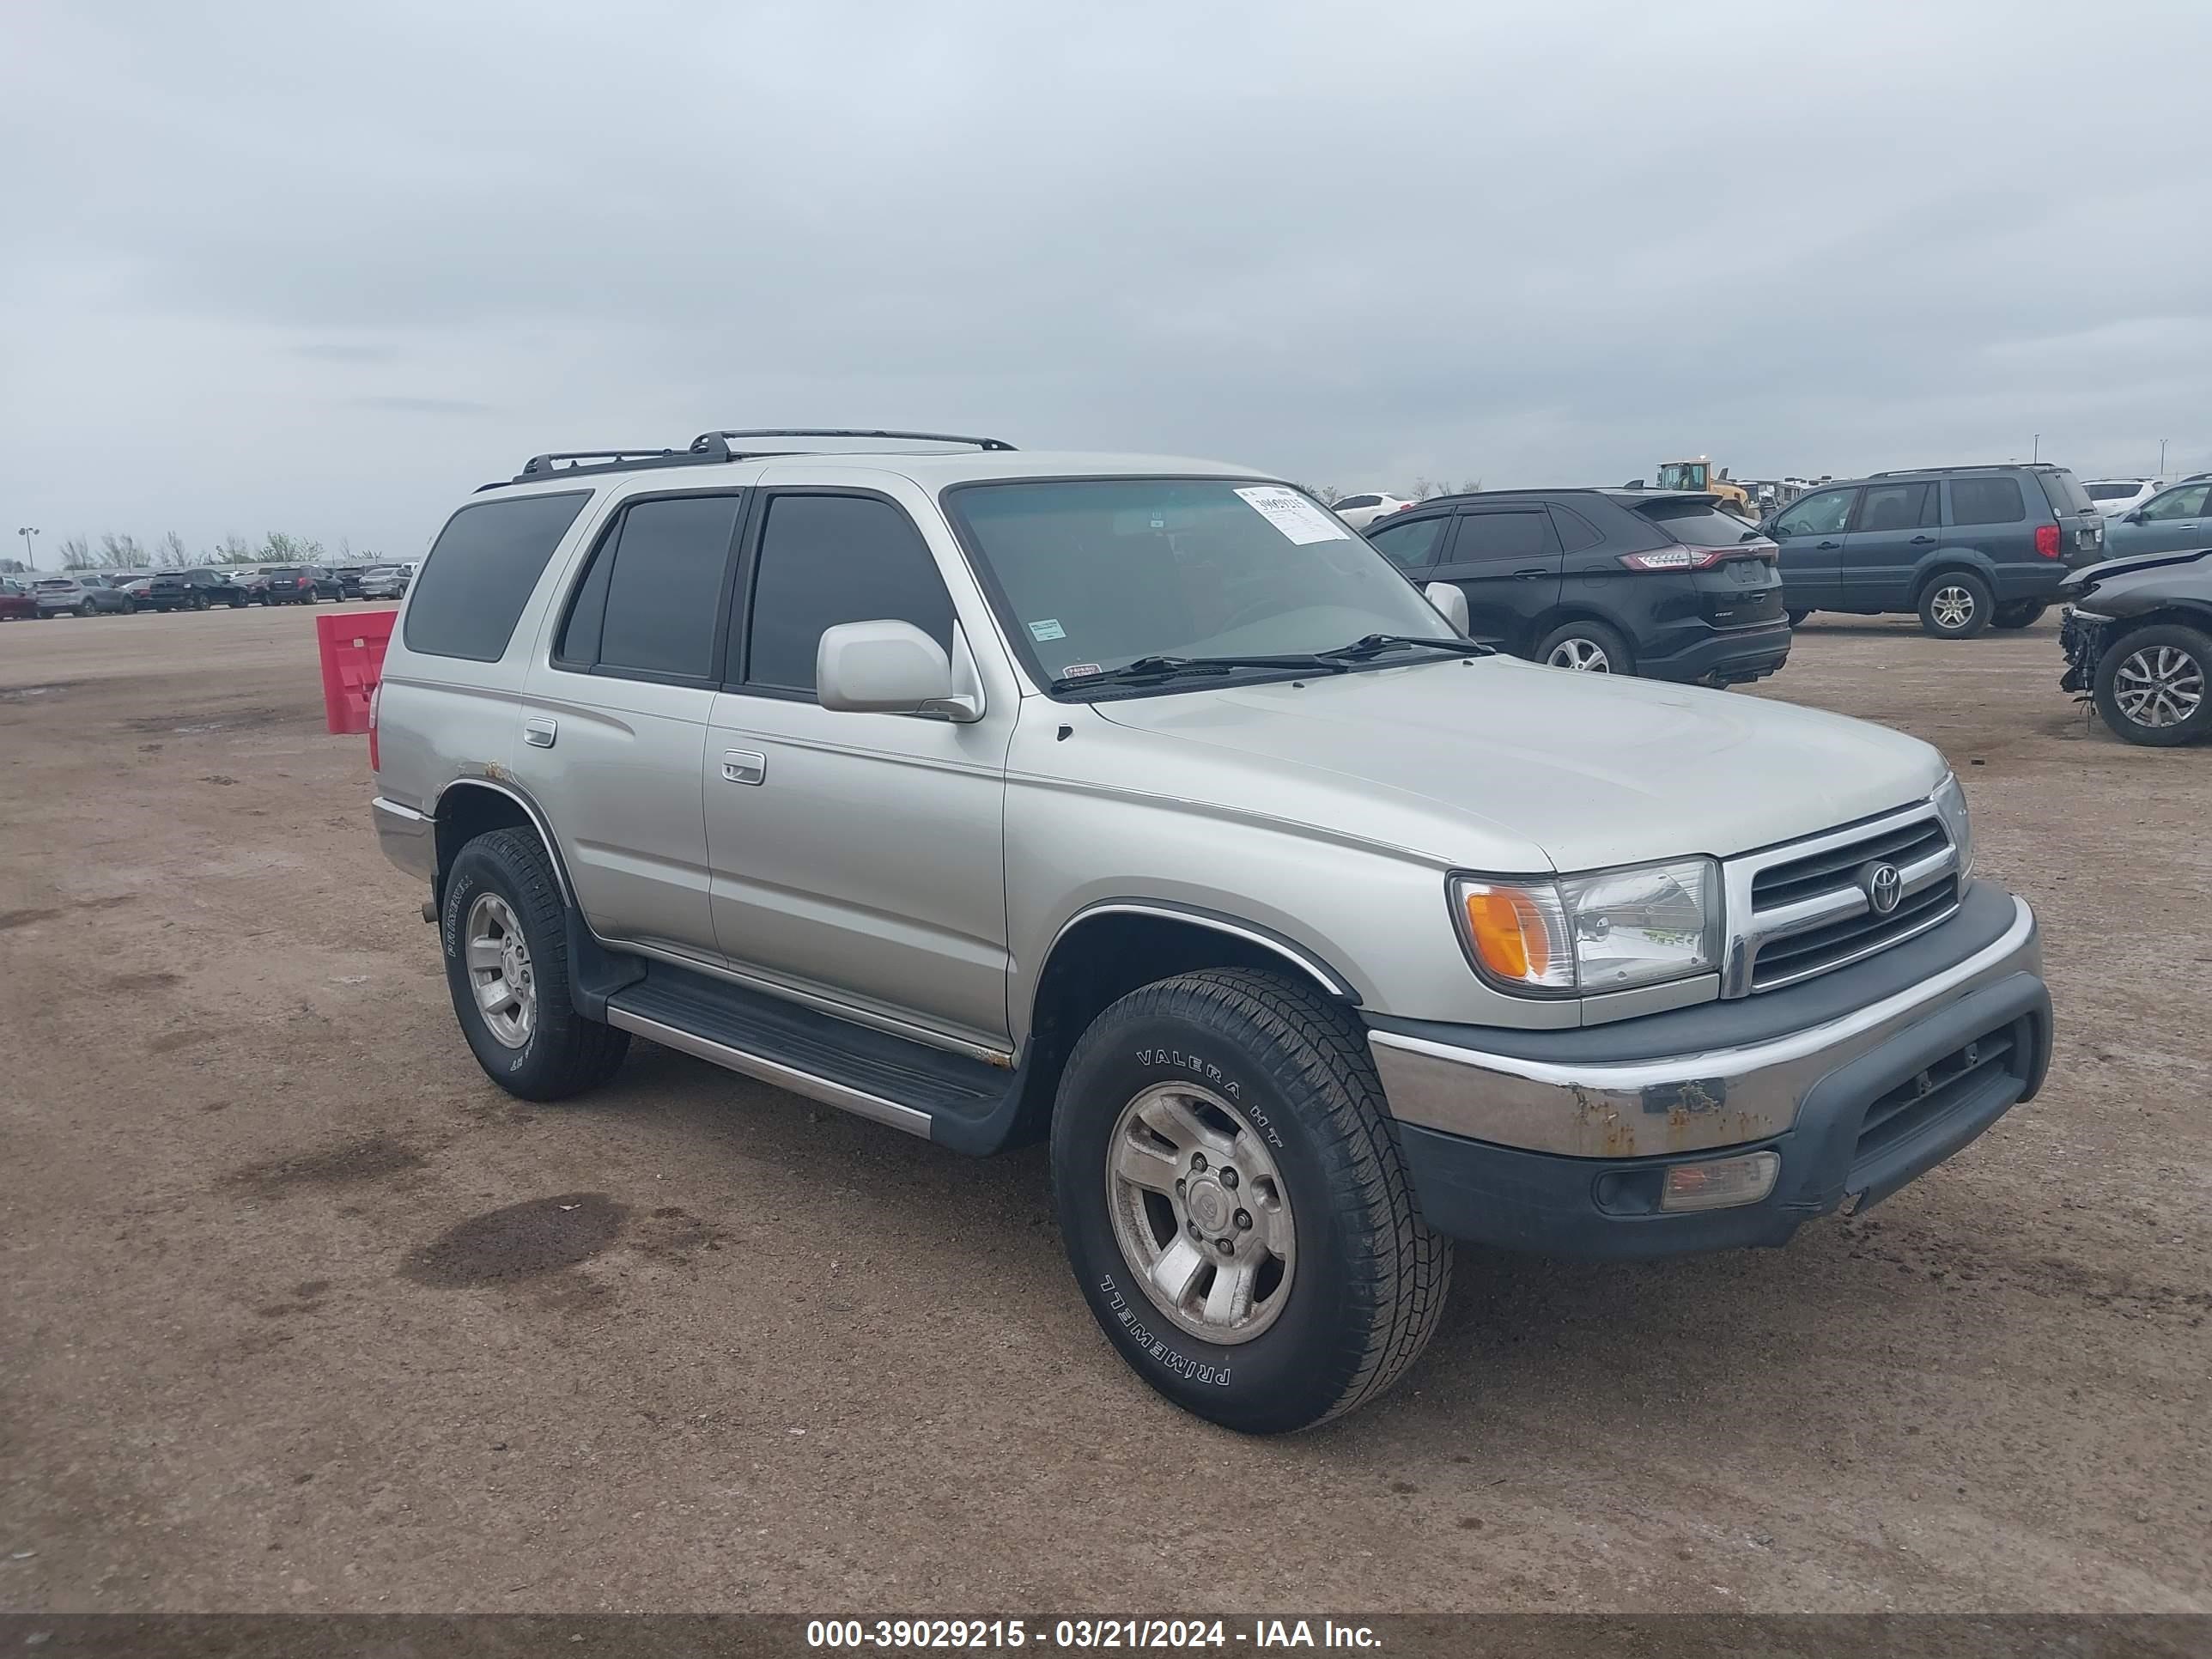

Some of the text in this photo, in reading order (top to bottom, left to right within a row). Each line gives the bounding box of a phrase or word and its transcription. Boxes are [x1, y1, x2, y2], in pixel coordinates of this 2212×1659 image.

[1136, 1049, 1284, 1148] VALERA HT
[1100, 1273, 1231, 1386] PRIMEWELL
